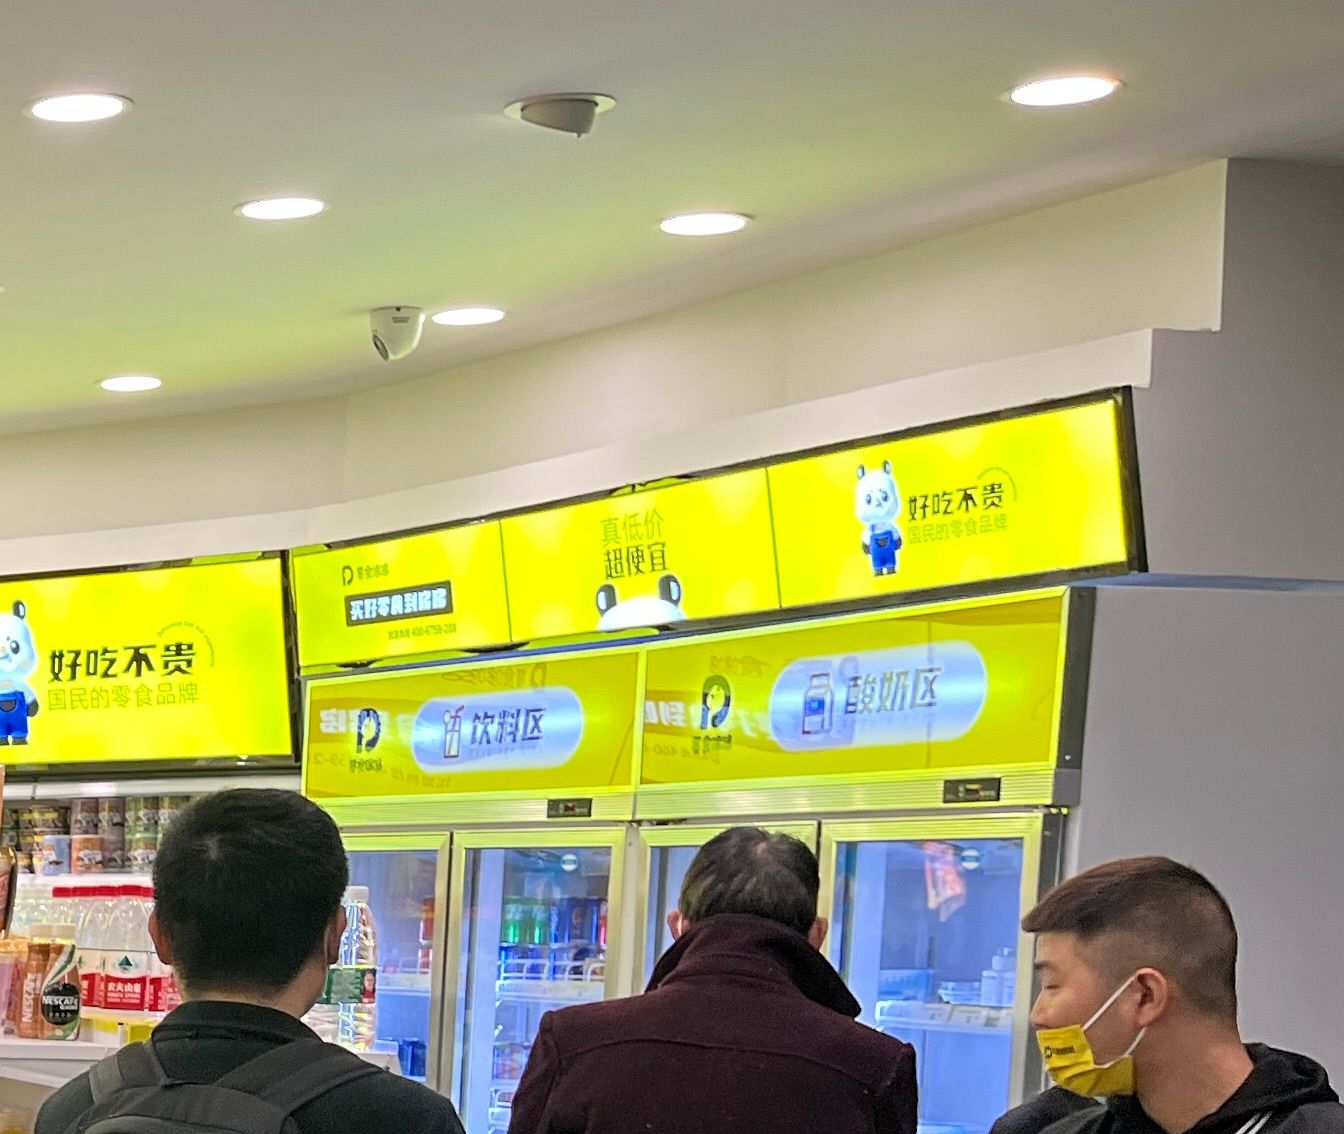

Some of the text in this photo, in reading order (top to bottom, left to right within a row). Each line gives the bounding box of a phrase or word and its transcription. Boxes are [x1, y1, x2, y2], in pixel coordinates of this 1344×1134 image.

[907, 481, 1006, 526] 好吃不贵
[599, 508, 665, 550] 真低价
[906, 513, 1011, 547] 国民的零食品牌
[602, 540, 672, 581] 超便宜
[48, 640, 198, 683] 好吃不贵
[47, 681, 201, 713] 国民的零食品牌
[470, 706, 548, 746] 饮料区
